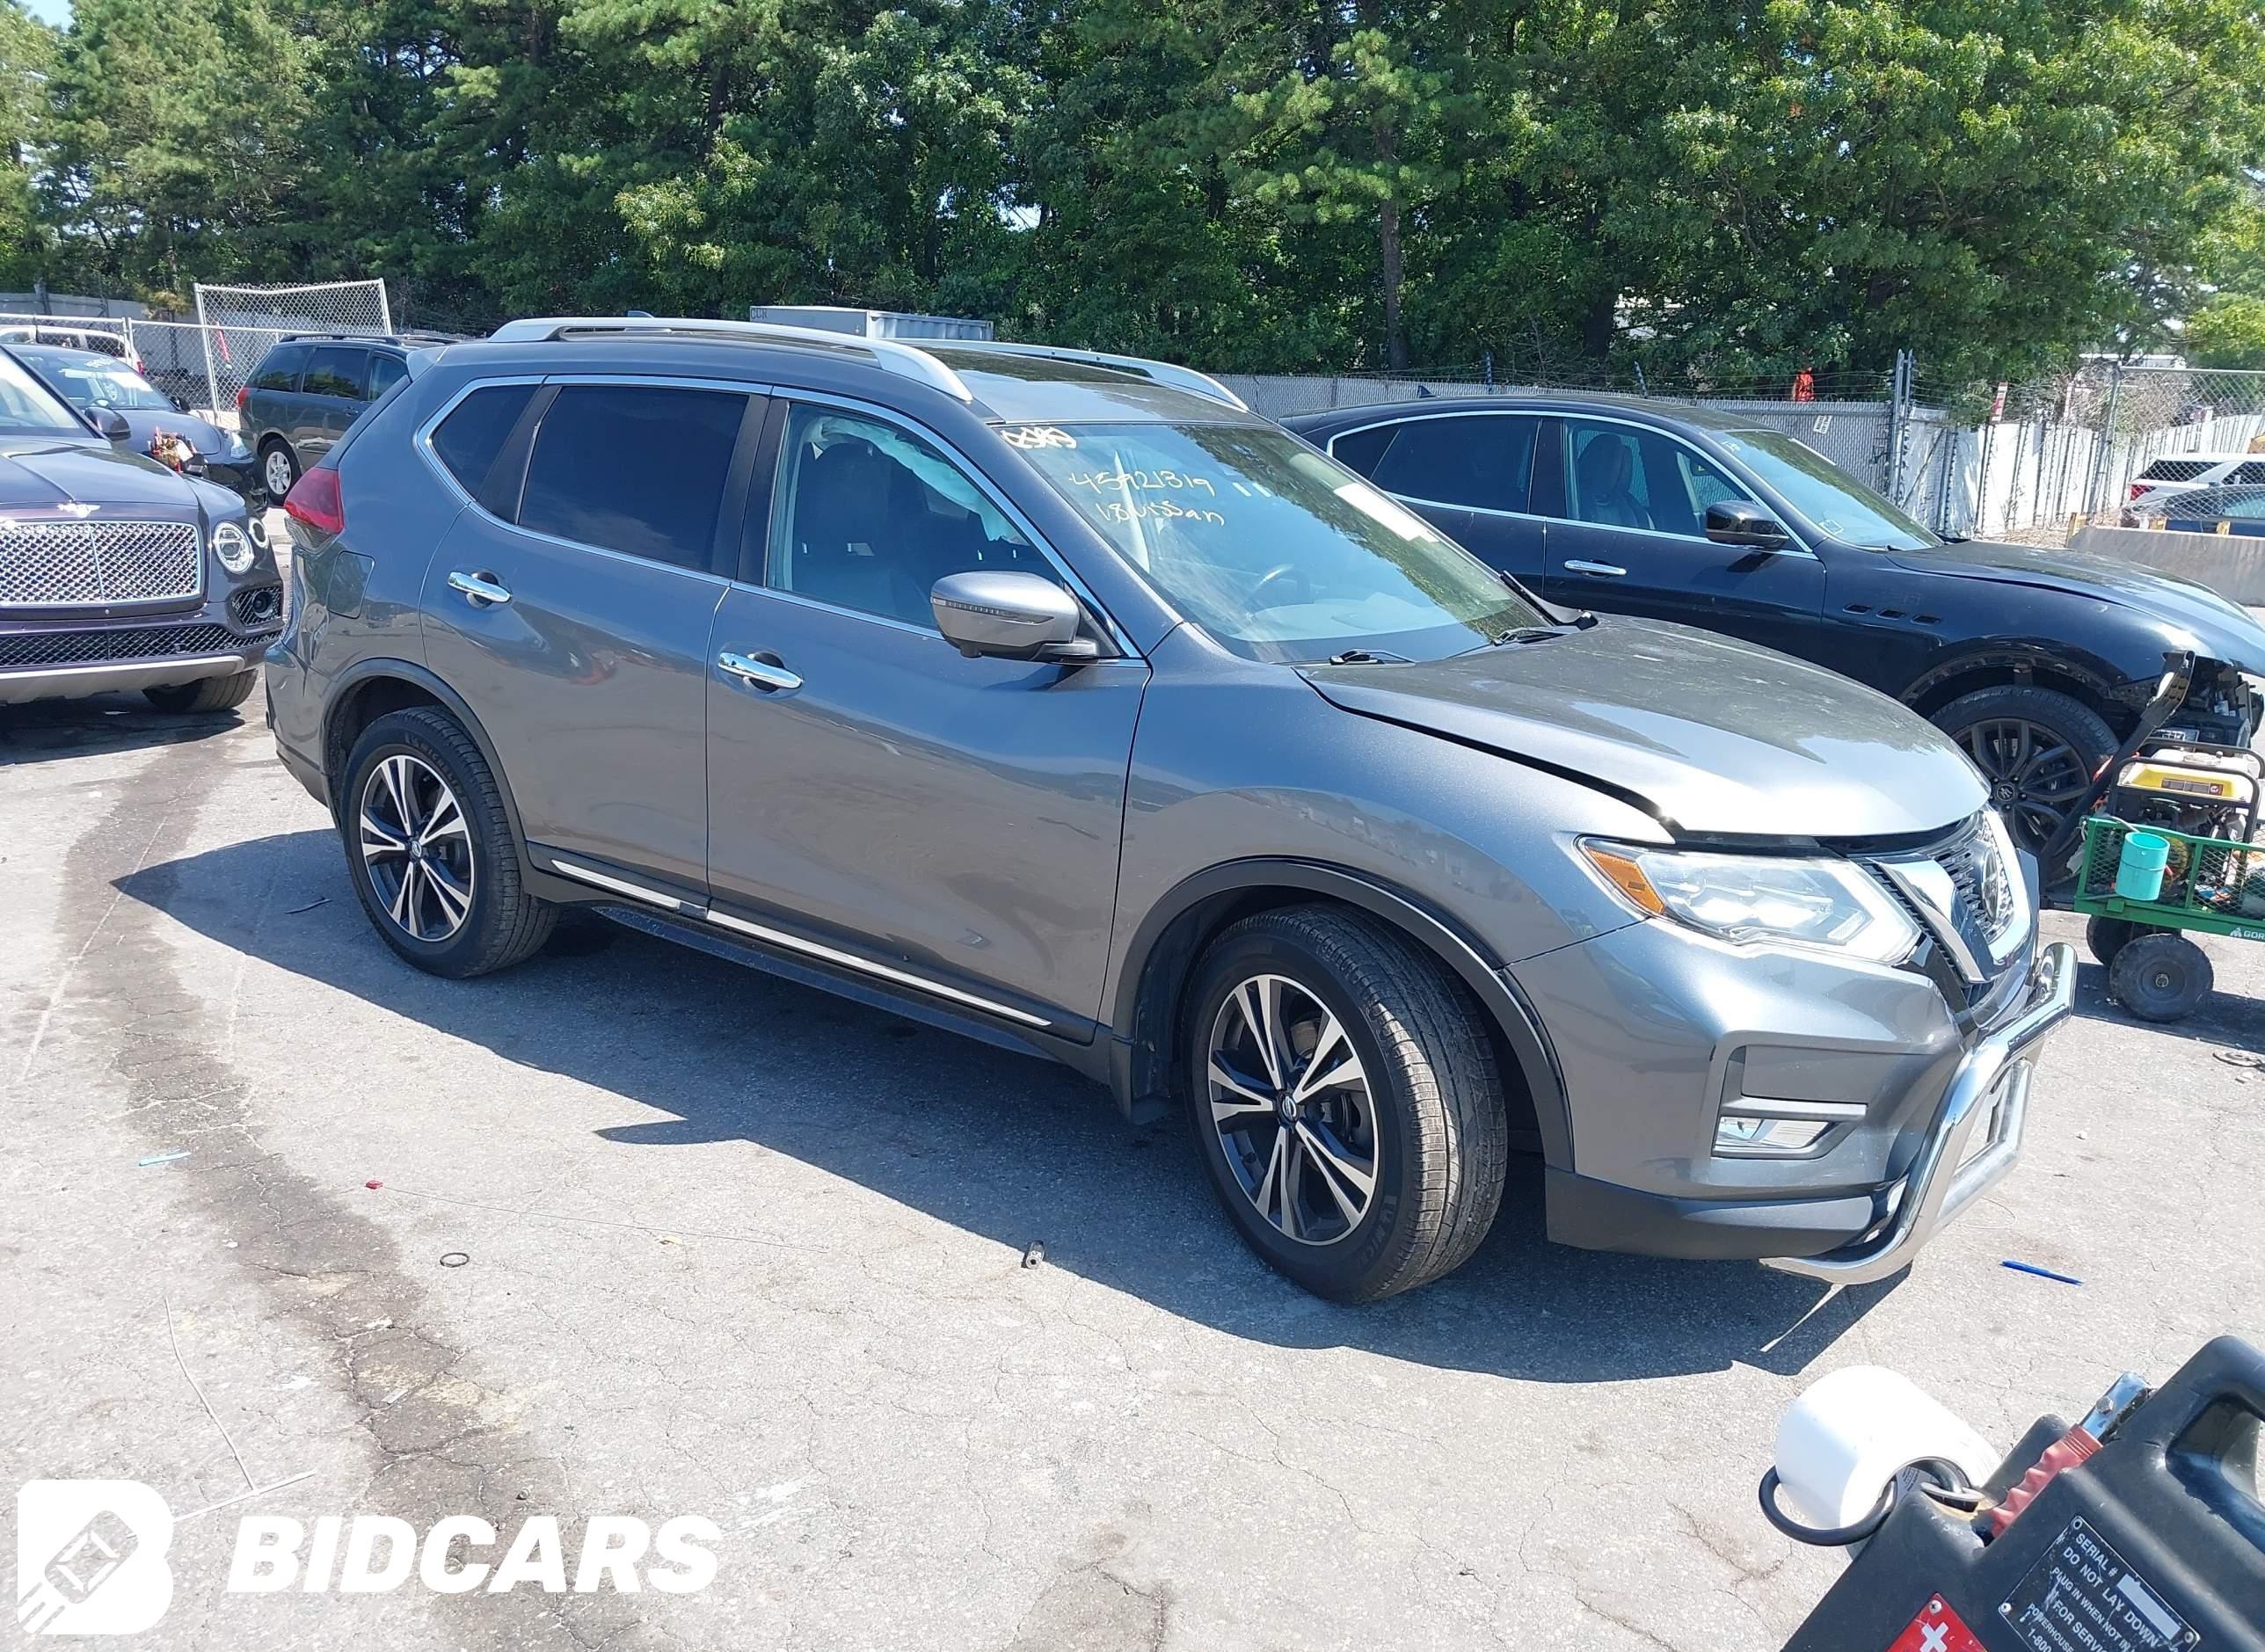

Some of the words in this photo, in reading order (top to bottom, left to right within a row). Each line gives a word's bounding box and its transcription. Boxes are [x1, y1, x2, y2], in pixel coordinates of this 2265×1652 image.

[2244, 929, 2265, 940] GOR
[2076, 1533, 2108, 1570] SERIAL
[2050, 1567, 2073, 1591] PLUG
[2071, 1588, 2082, 1600] IN
[2080, 1597, 2105, 1624] WHEN
[2102, 1621, 2122, 1641] NOT
[2063, 1546, 2080, 1565] DO
[2079, 1563, 2103, 1588] NOT
[2101, 1587, 2125, 1612] LAY
[2123, 1610, 2159, 1647] DOWN
[2028, 1603, 2074, 1652] POWERHOUSE
[2052, 1599, 2075, 1625] FOR
[2072, 1621, 2108, 1652] SERVI
